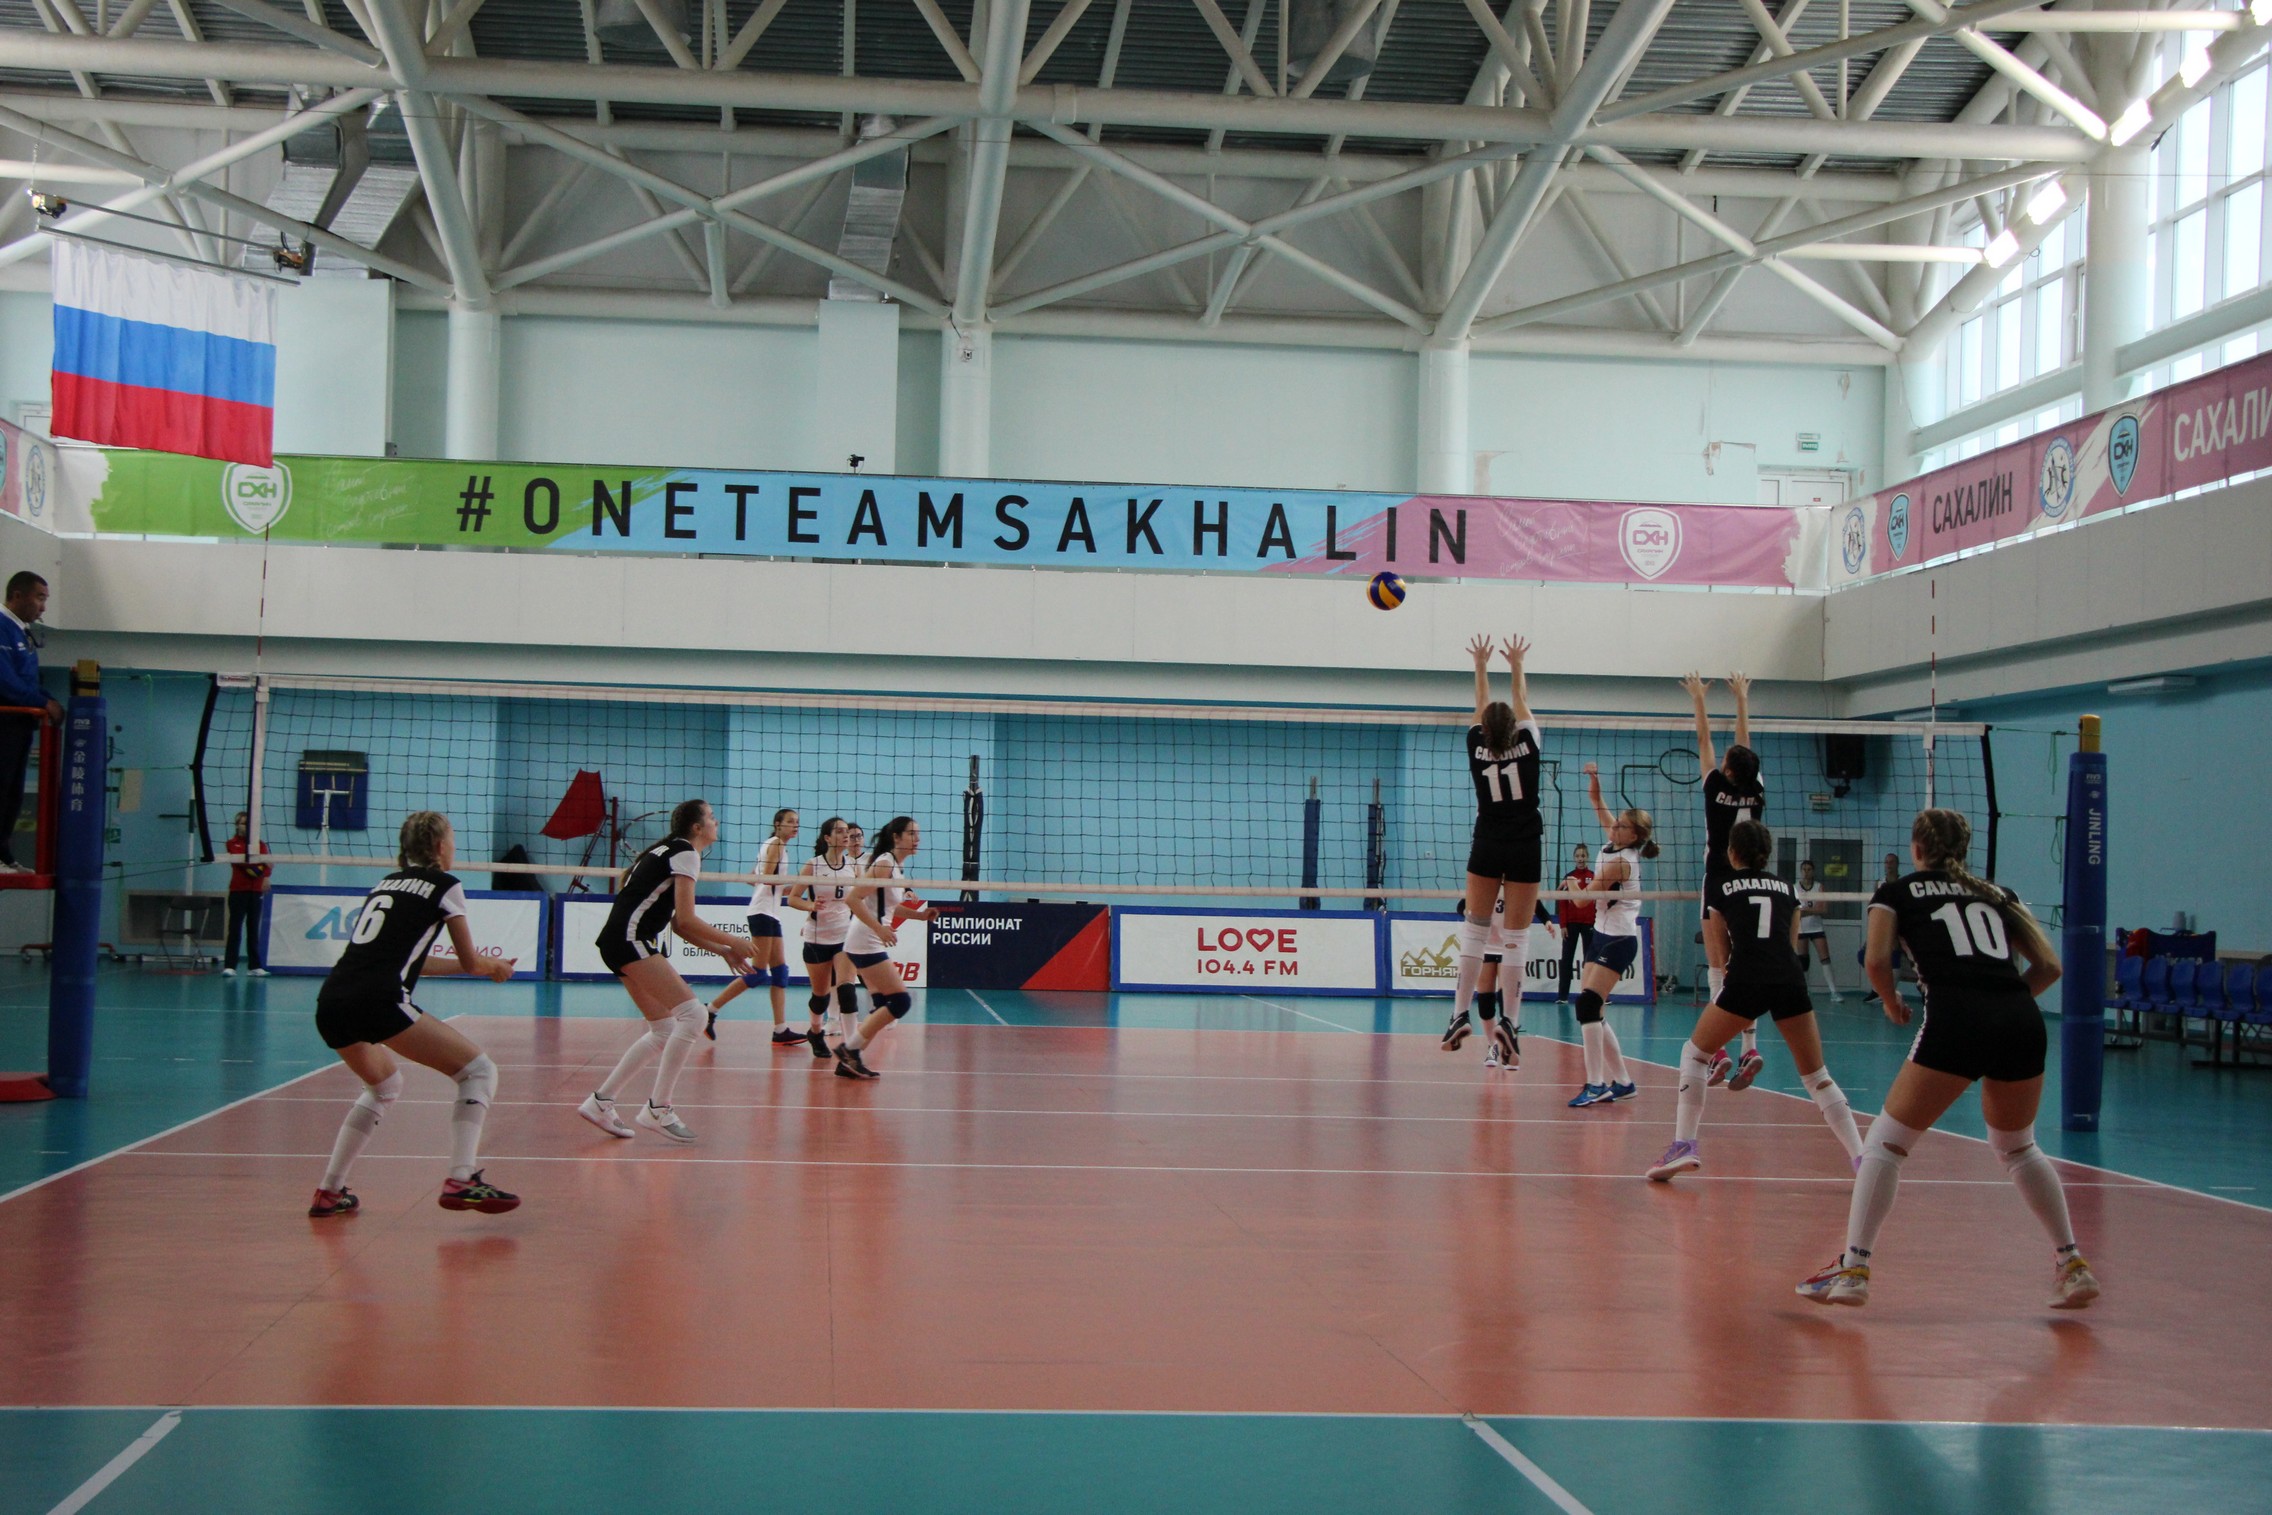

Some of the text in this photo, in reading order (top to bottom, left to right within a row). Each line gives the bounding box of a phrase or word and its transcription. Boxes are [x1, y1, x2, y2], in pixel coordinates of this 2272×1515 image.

[2174, 387, 2272, 462] САХАЛИ
[456, 475, 1468, 567] #ONETEAMSAKHALIN
[1932, 471, 2013, 534] САХАЛИН
[1482, 762, 1523, 802] 11
[2088, 808, 2101, 865] JINLING
[835, 885, 844, 899] 6
[1495, 899, 1505, 913] 3
[1722, 877, 1790, 896] САХАЛИН
[351, 894, 394, 944] 6
[933, 917, 1022, 930] ЧЕМПИОНАТ
[1748, 896, 1772, 938] 7
[1930, 902, 2009, 959] 10
[433, 944, 503, 957] РАИО
[932, 932, 992, 945] РОССИИ
[1198, 959, 1298, 975] 104.4 FM
